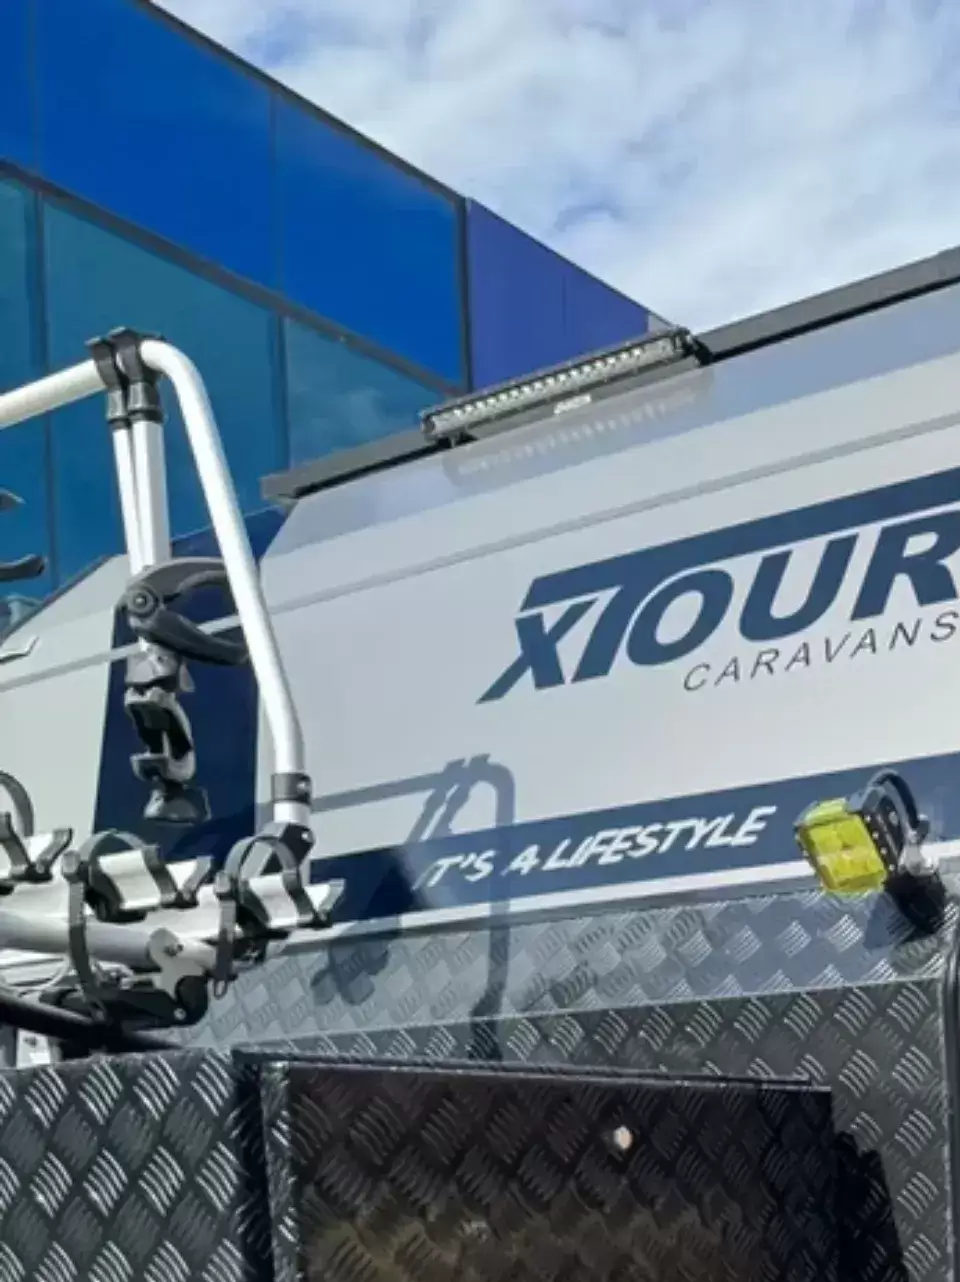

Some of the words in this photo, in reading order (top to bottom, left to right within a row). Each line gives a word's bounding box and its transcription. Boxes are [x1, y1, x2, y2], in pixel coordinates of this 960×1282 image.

[682, 610, 960, 693] CARAVANS
[501, 843, 541, 877] A
[541, 804, 778, 873] LIFESTYLE
